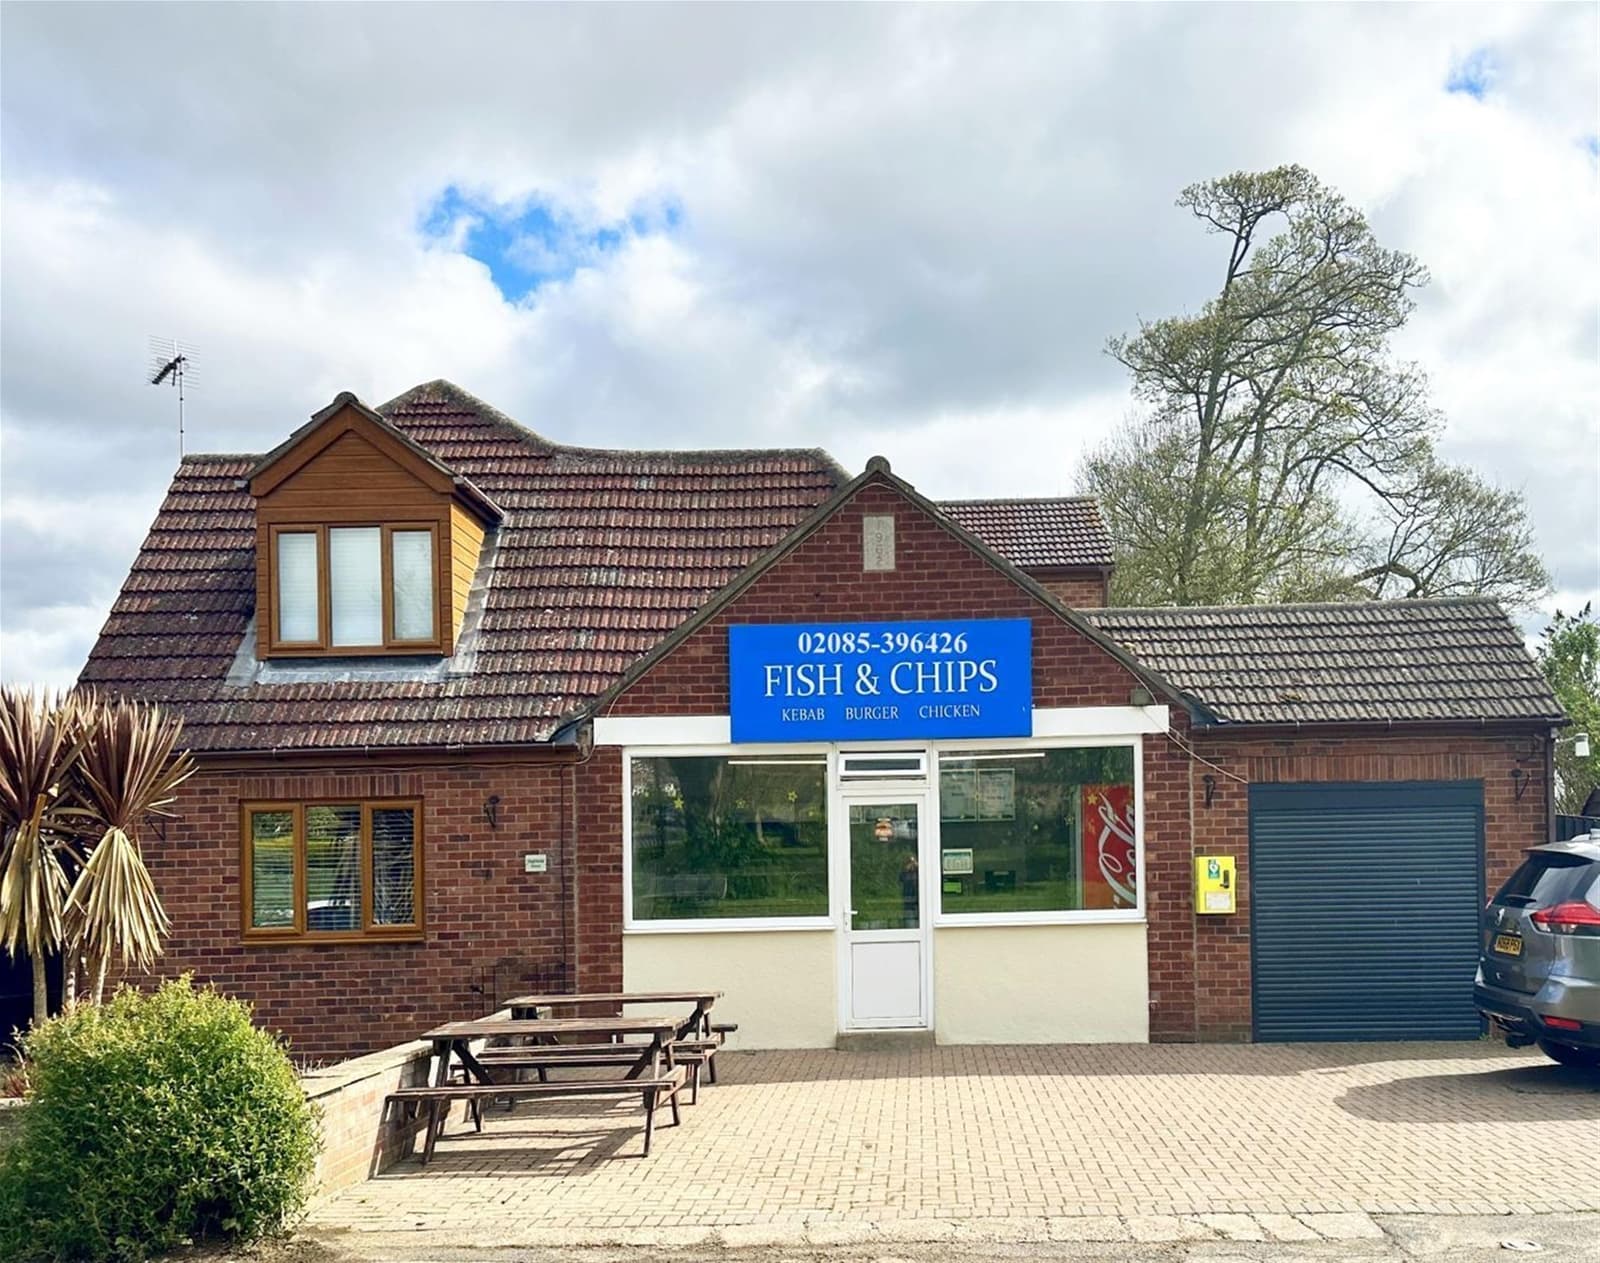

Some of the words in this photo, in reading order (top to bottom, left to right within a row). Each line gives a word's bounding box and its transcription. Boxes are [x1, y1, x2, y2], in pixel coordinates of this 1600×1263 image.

[798, 632, 968, 654] 02085-396426
[764, 664, 843, 697] FISH
[855, 663, 881, 695] &
[890, 660, 998, 694] CHIPS
[782, 708, 825, 721] KEBAB
[846, 706, 899, 720] BURGER
[919, 705, 980, 718] CHICKEN
